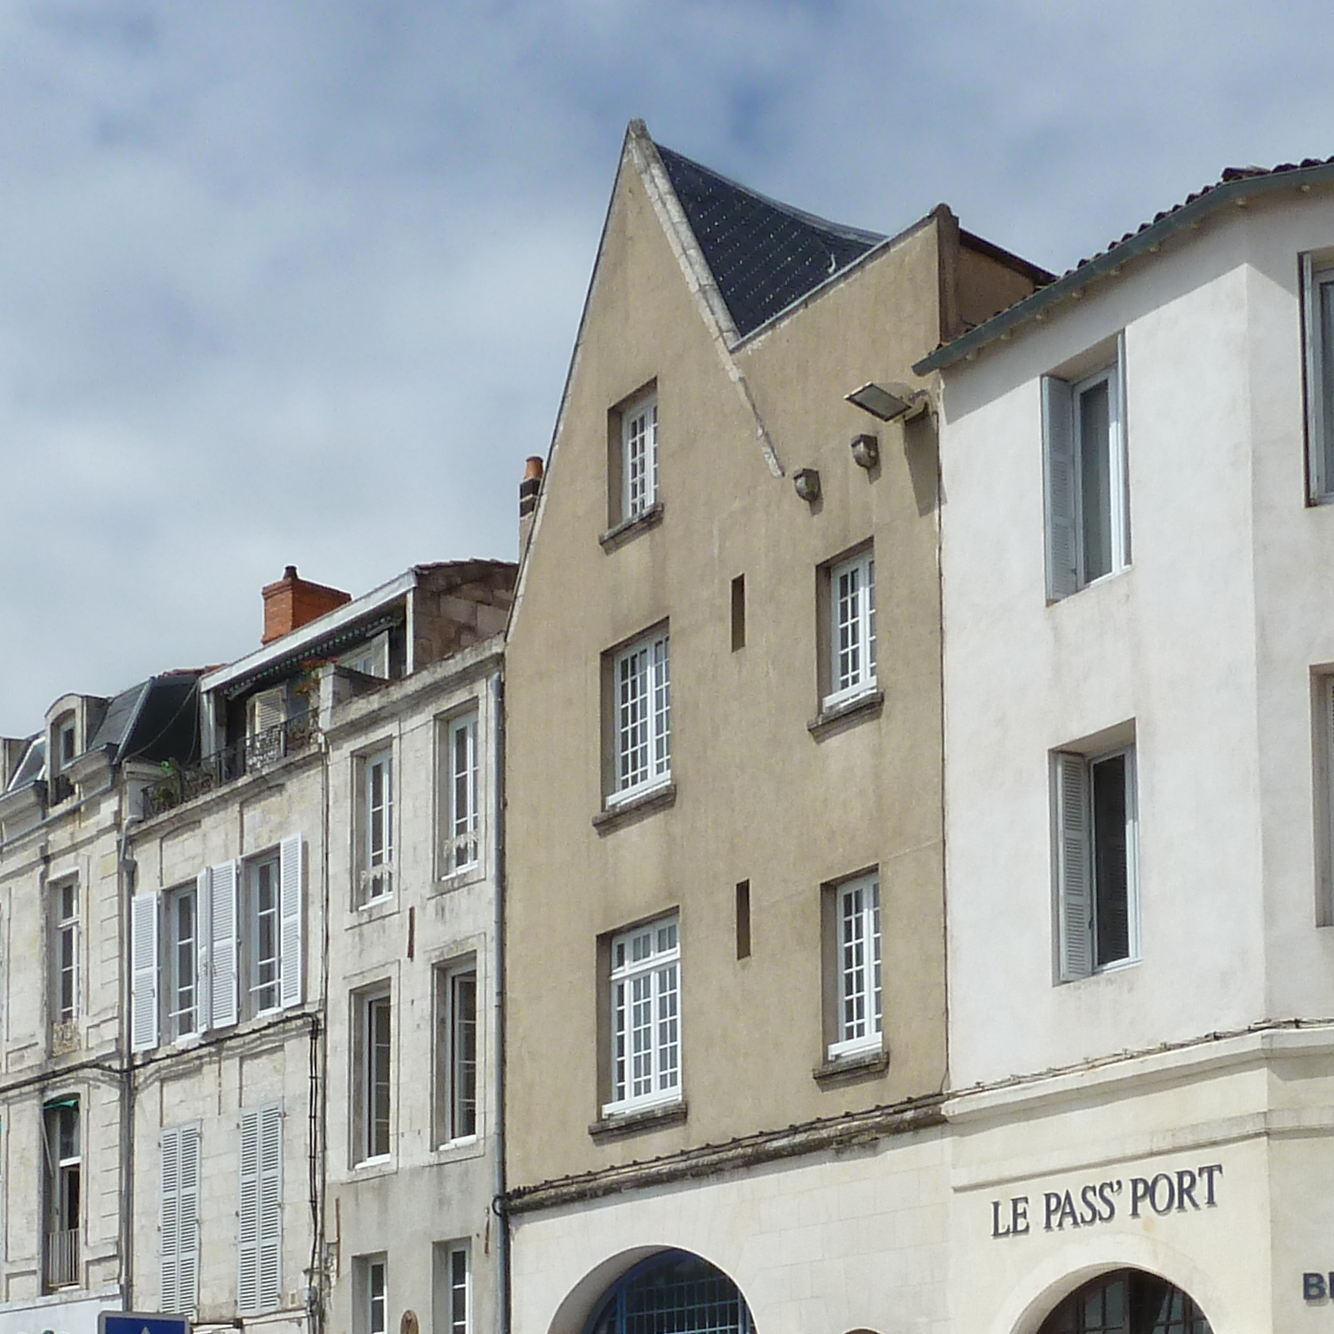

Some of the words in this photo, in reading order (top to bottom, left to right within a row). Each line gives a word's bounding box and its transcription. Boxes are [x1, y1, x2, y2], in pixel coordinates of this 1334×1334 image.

[991, 1196, 1031, 1239] LE
[1043, 1179, 1123, 1232] PASS'
[1129, 1163, 1224, 1219] PORT
